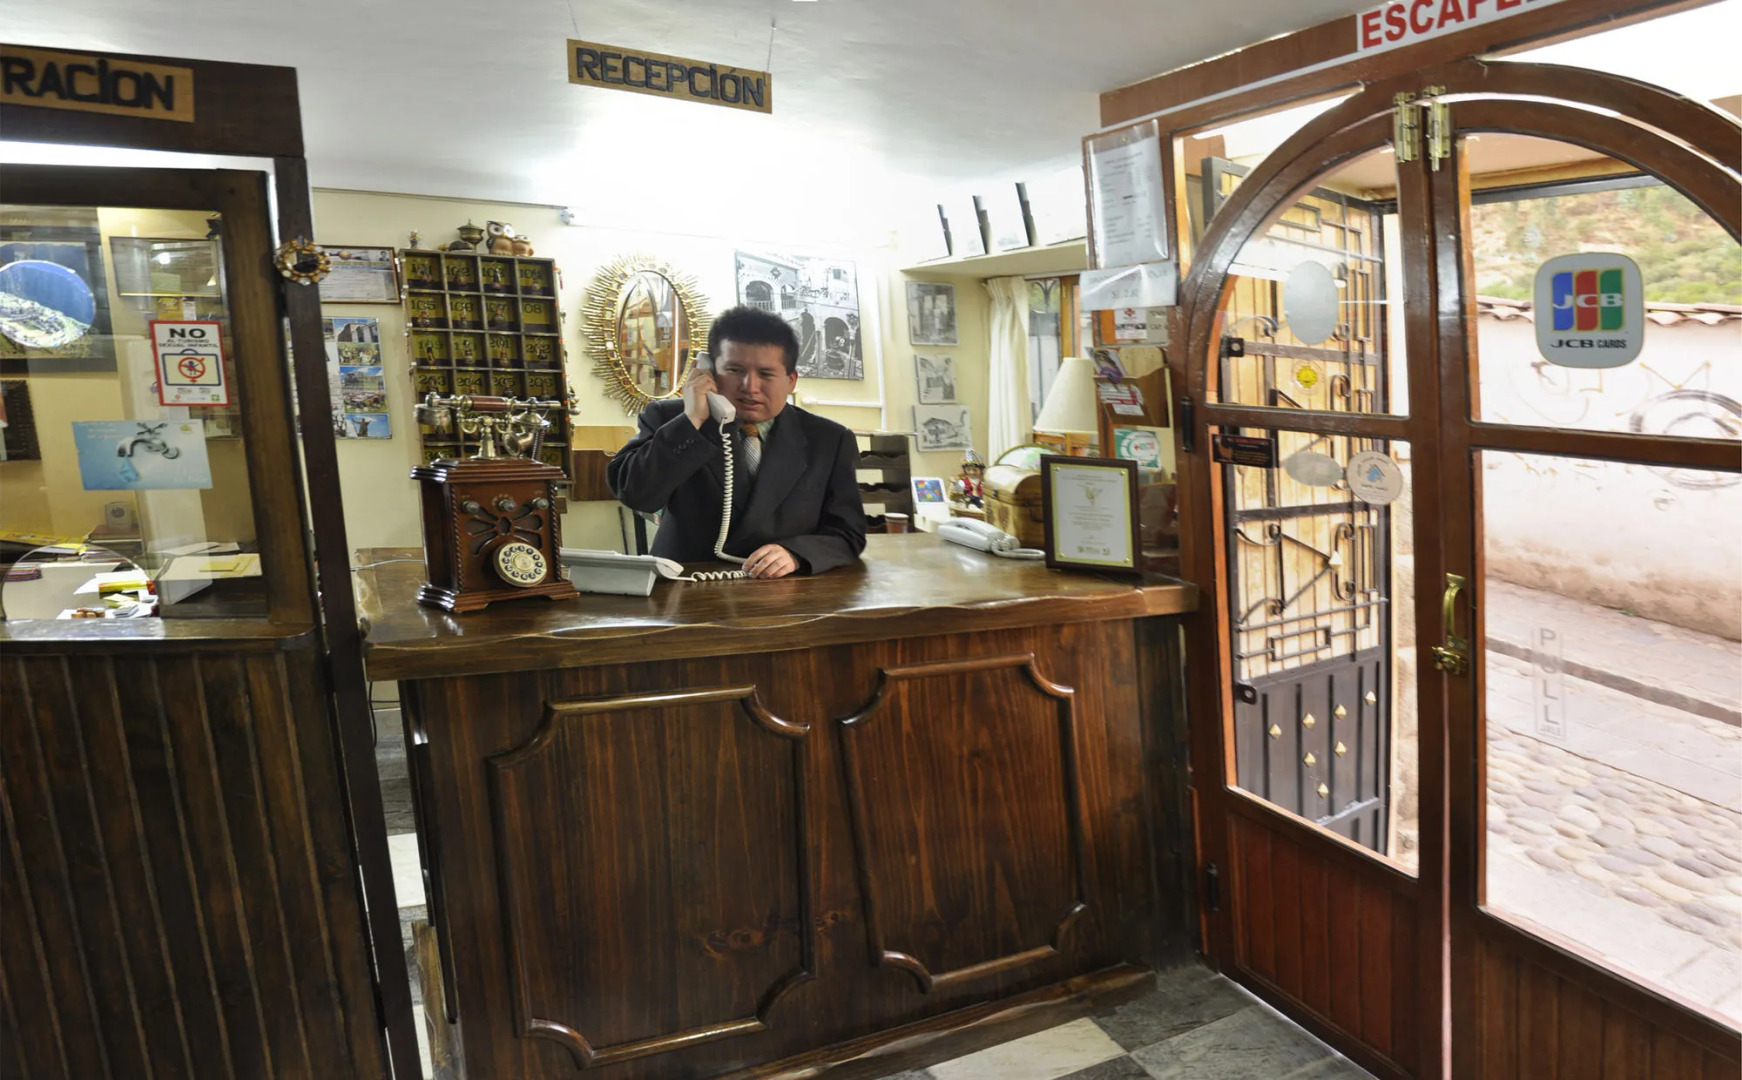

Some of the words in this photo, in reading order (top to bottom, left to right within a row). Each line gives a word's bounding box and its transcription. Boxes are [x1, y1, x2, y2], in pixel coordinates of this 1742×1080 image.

[1362, 0, 1521, 49] ESCAP
[576, 46, 764, 107] RECEPCIÓN
[446, 266, 469, 277] 102
[411, 300, 436, 311] 105
[1552, 293, 1623, 309] JCB
[523, 303, 543, 314] 08
[169, 328, 206, 339] NO
[1550, 339, 1594, 348] JCB
[1597, 339, 1627, 349] CARDS
[1540, 627, 1559, 725] PULL
